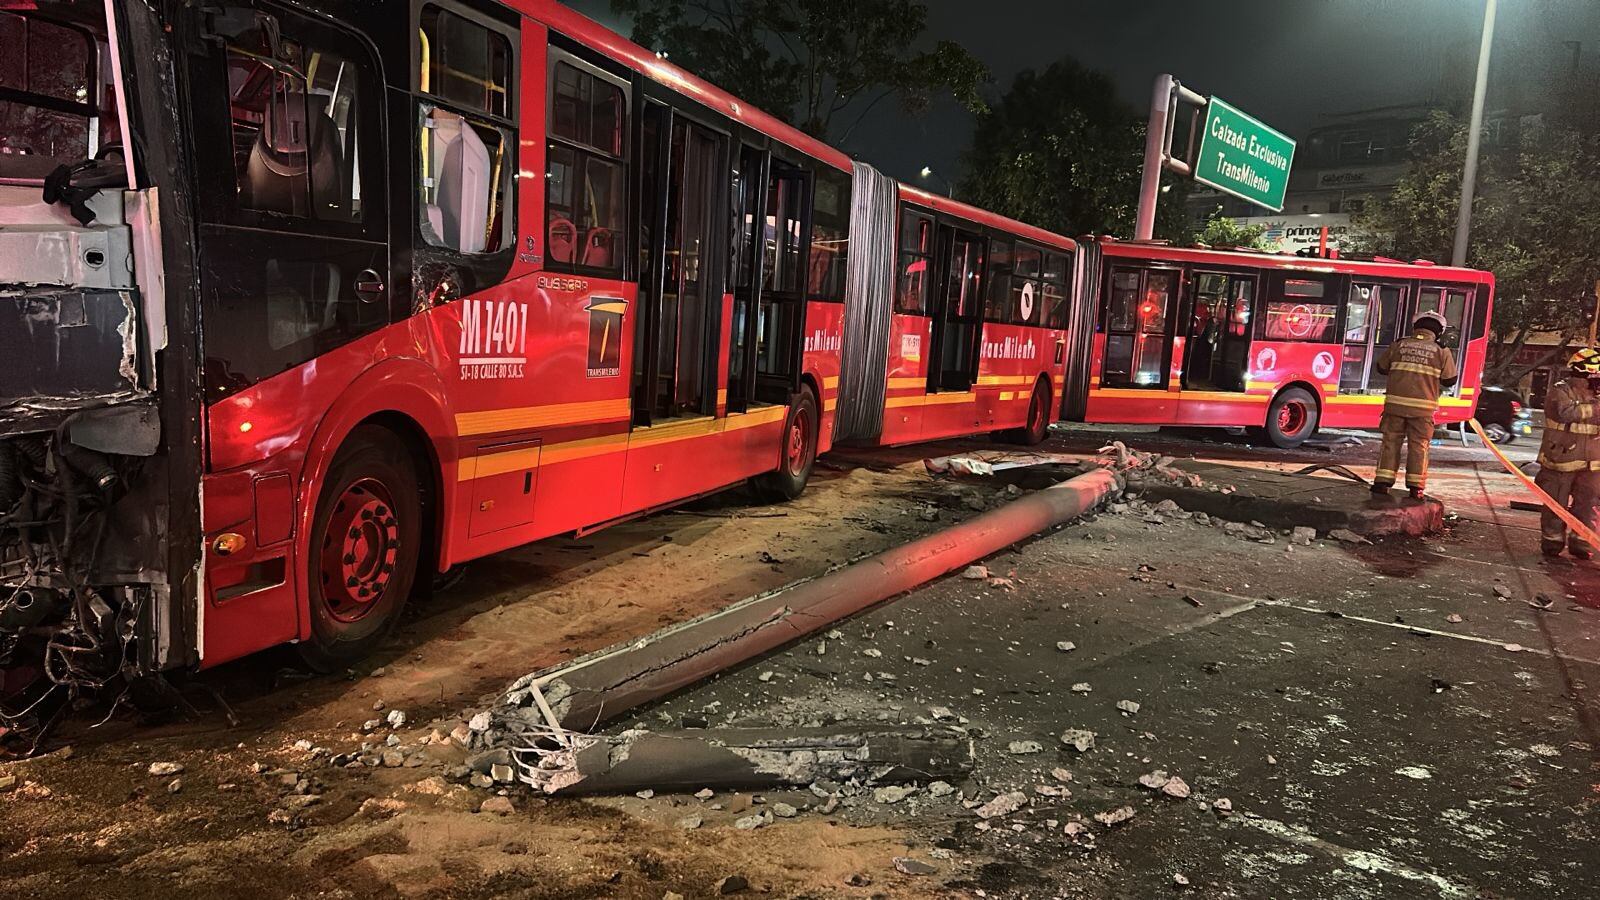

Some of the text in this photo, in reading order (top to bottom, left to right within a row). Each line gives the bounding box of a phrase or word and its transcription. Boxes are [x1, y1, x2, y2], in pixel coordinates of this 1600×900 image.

[1212, 116, 1287, 171] Calzada Exclusiva
[1216, 151, 1270, 193] TransMilenio
[1286, 224, 1347, 238] primaera
[480, 364, 498, 379] CALLE
[499, 364, 507, 378] 80
[507, 364, 524, 379] S.A.S.
[587, 368, 619, 377] TRANSMILENIO
